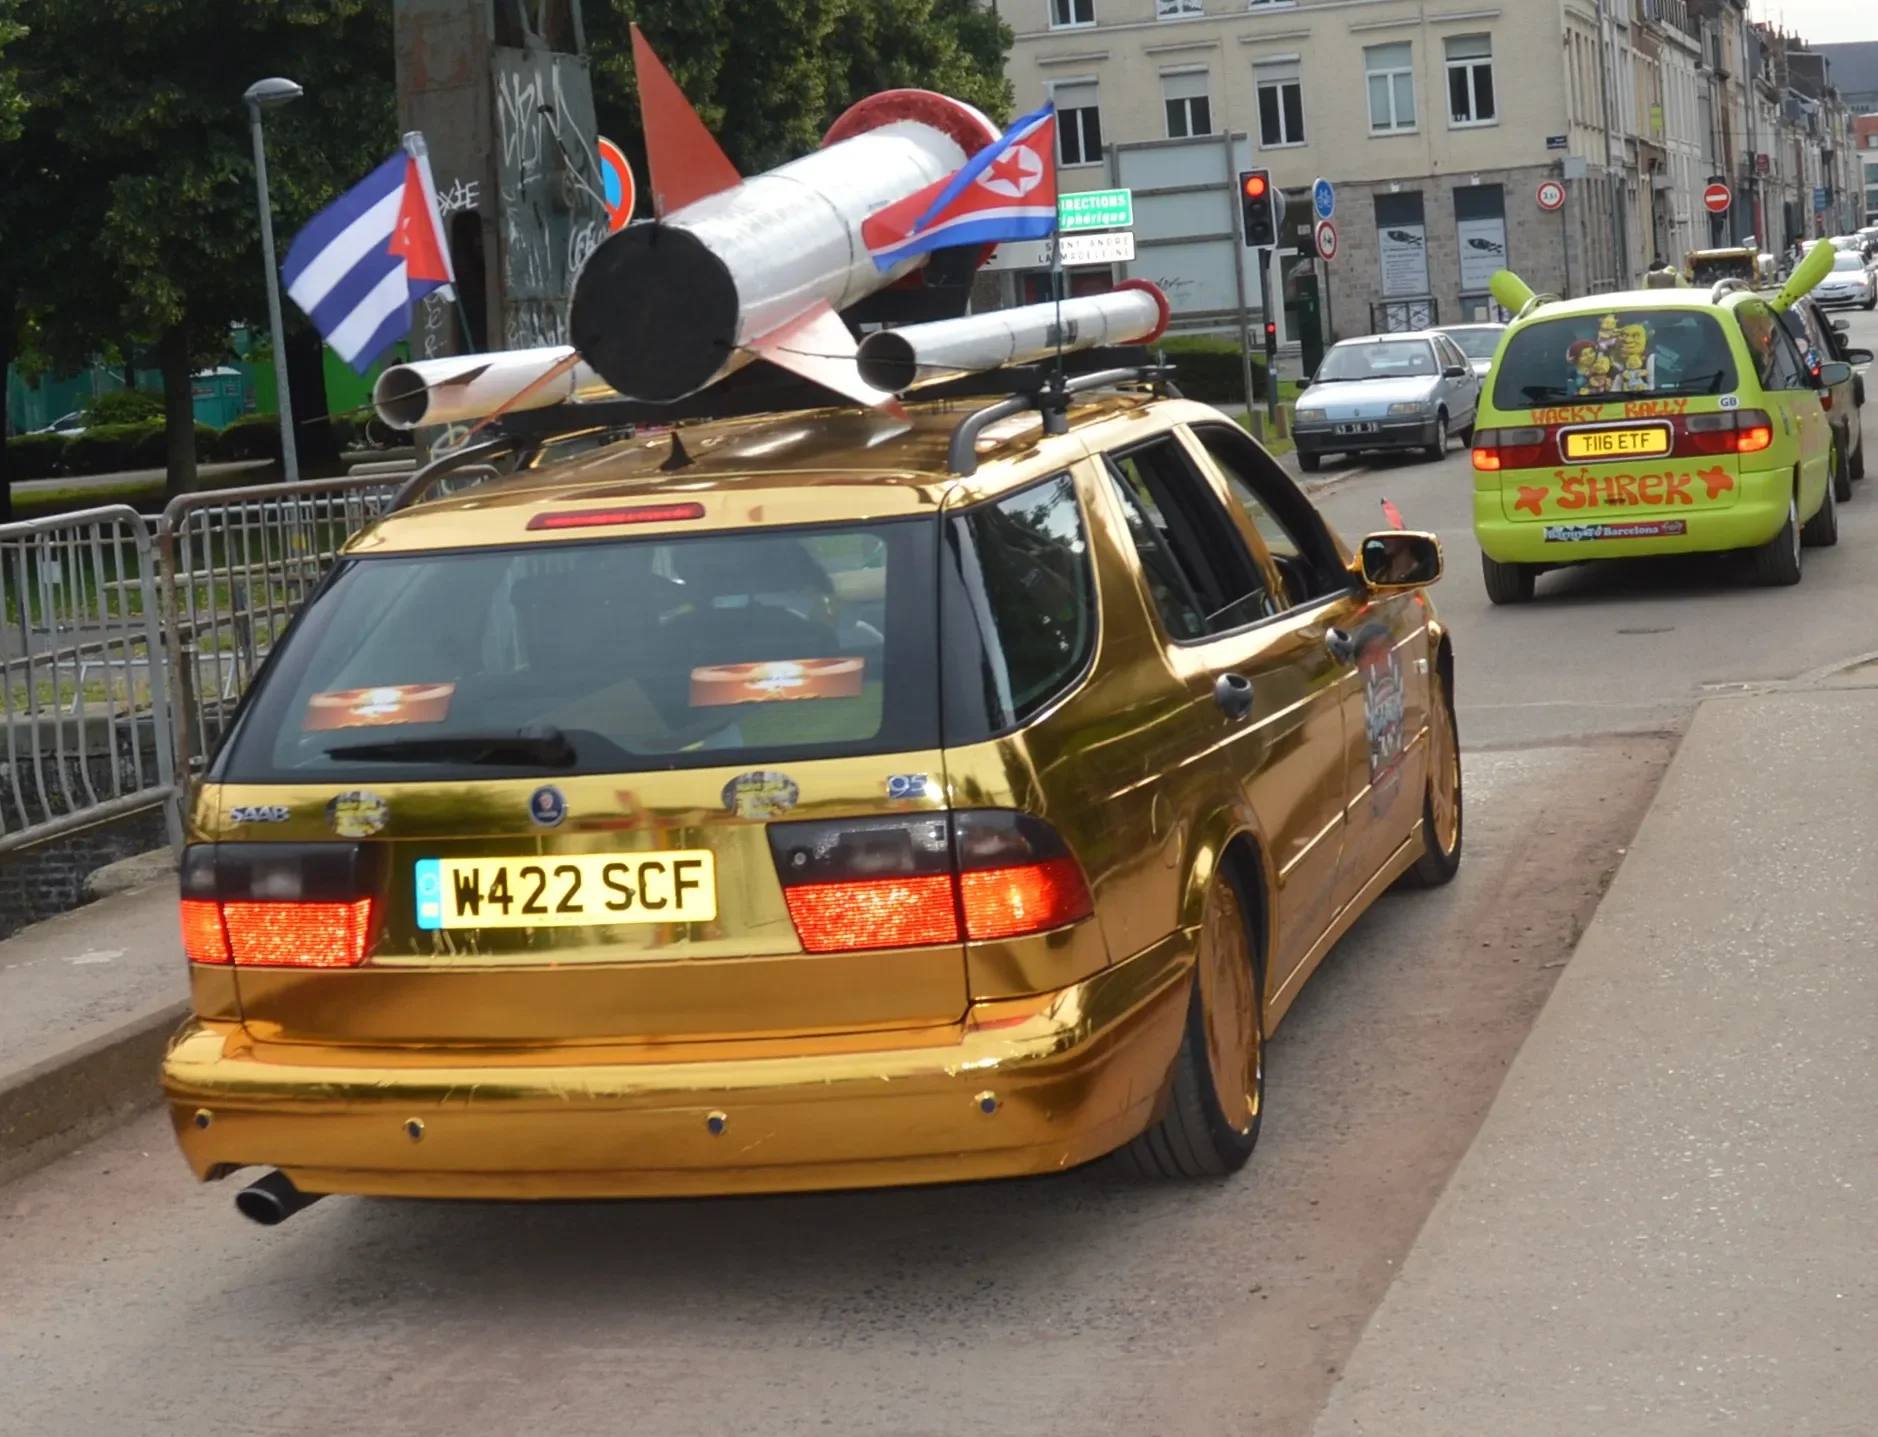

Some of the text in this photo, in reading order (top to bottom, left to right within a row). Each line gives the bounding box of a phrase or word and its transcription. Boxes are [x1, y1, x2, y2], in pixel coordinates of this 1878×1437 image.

[1060, 195, 1125, 210] IRECTIONS
[1045, 239, 1081, 251] SINT
[1624, 398, 1688, 419] RALLY
[1720, 397, 1738, 407] GB
[1582, 432, 1651, 452] T116 ETF
[1604, 525, 1659, 537] Barcelona
[231, 806, 289, 822] SAAB
[453, 859, 703, 917] W422 SCF
